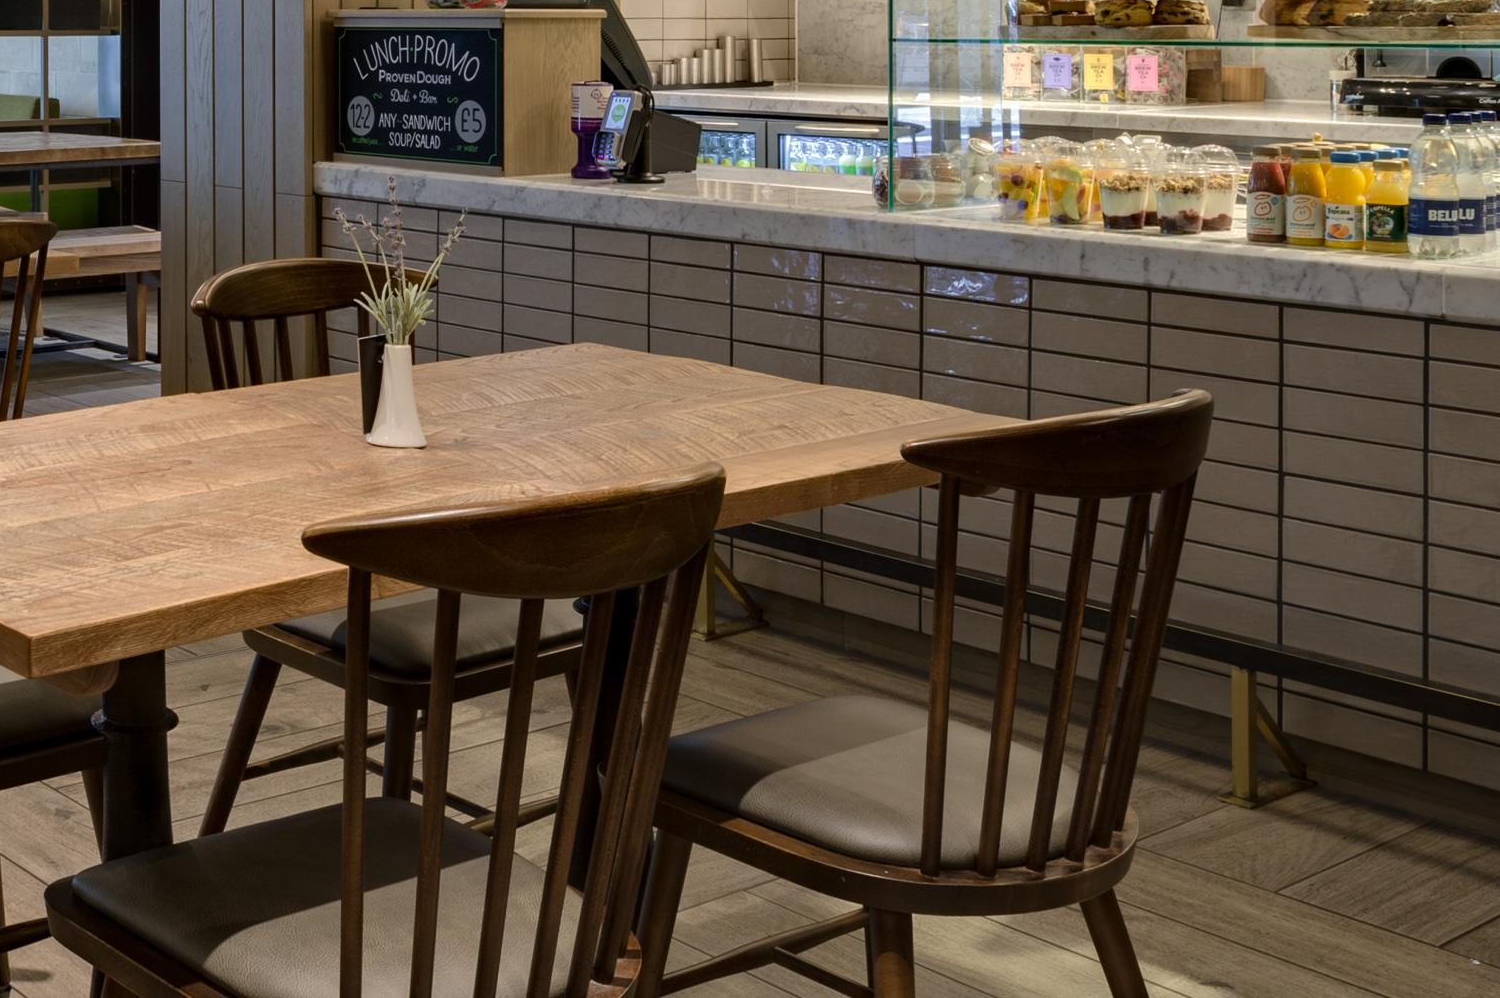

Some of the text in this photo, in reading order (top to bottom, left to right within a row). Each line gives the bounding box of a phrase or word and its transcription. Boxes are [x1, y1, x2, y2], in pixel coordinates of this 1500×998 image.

[378, 113, 451, 132] ANY SANDWICH
[461, 107, 483, 134] £5
